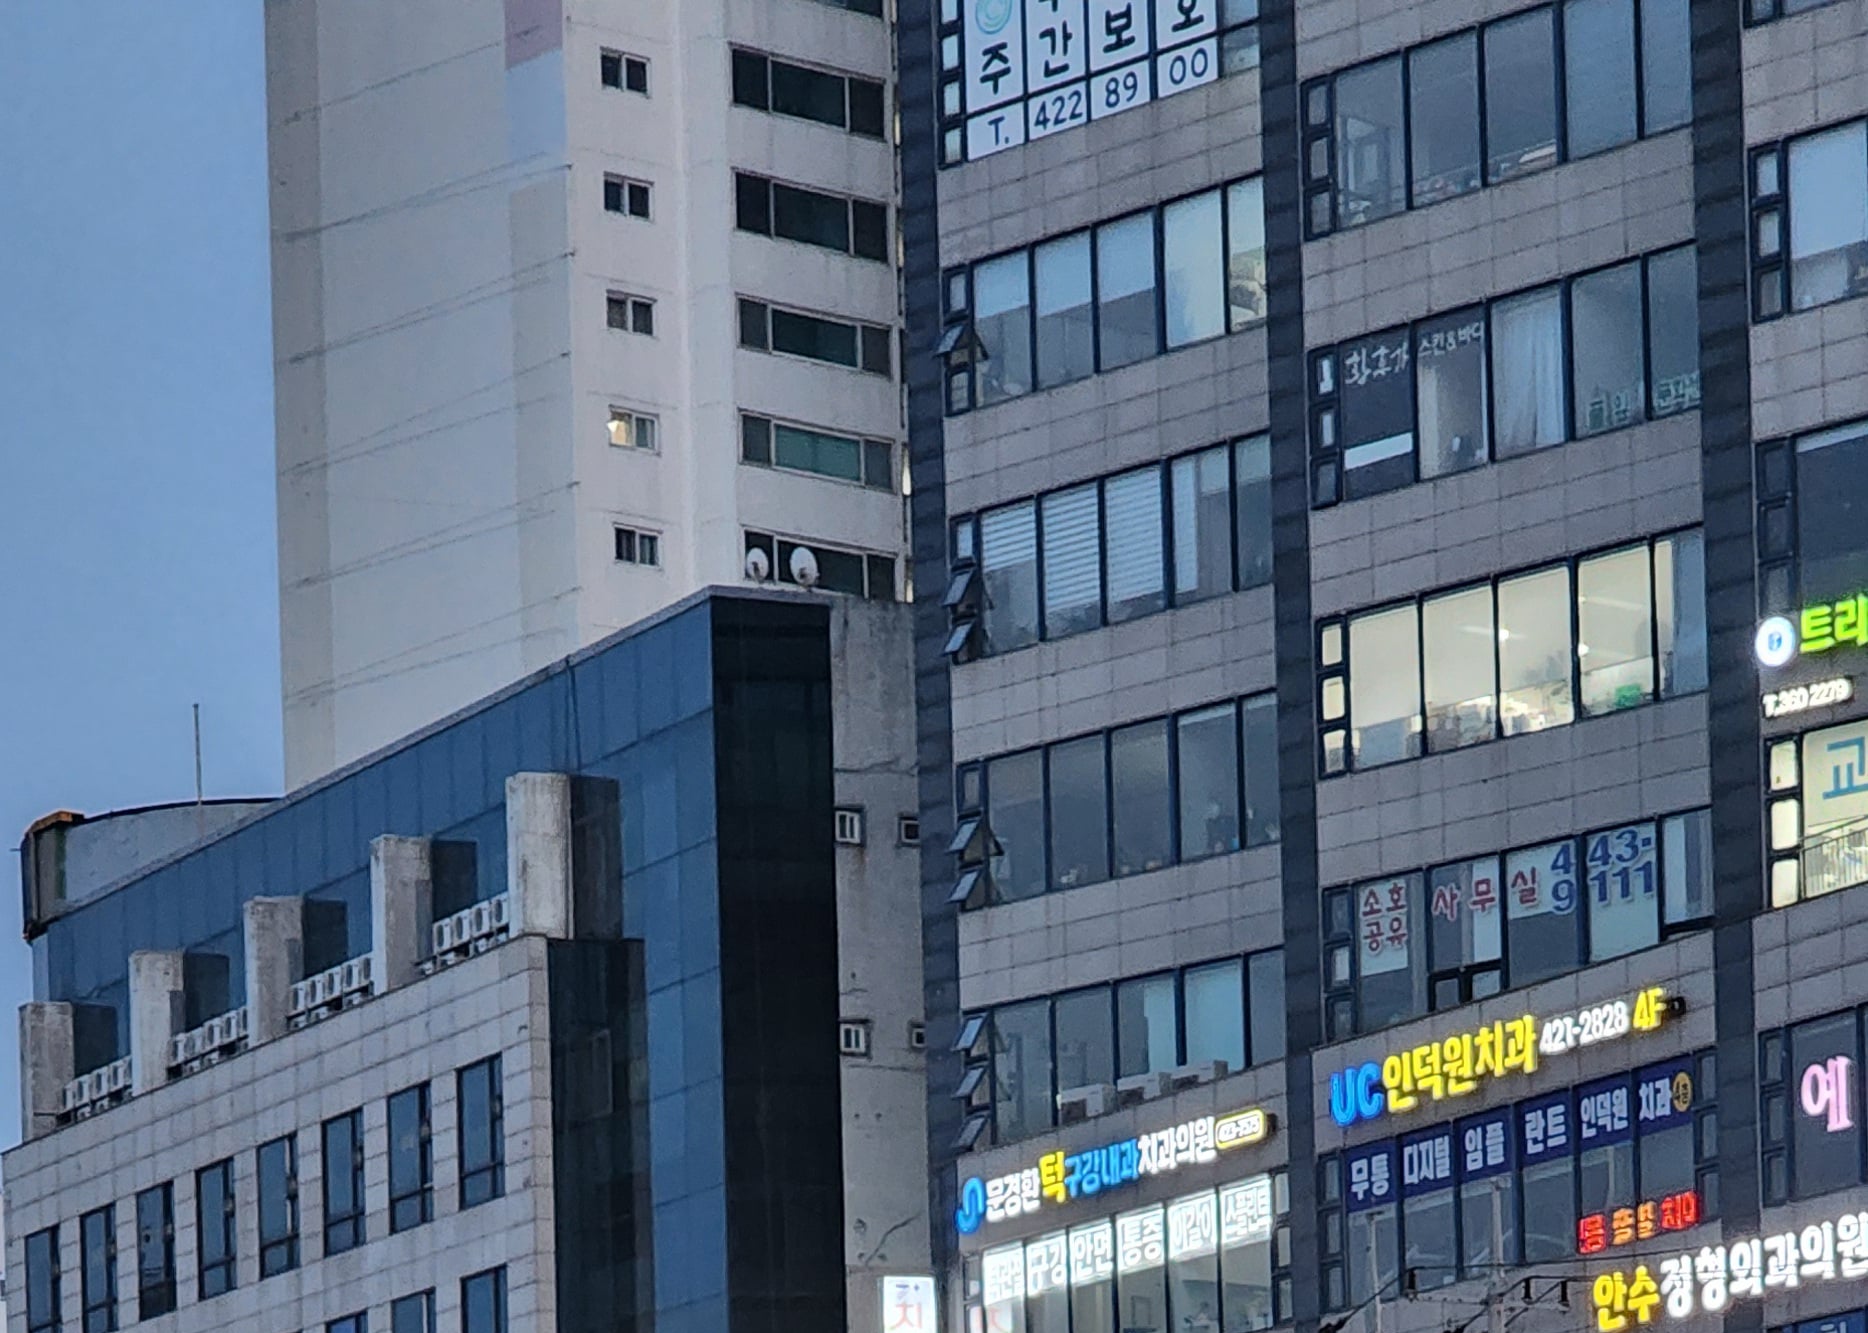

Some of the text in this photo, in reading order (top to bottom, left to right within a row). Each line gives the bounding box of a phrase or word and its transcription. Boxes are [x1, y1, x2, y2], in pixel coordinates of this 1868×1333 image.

[1033, 89, 1084, 130] 422
[1104, 71, 1138, 108] 89
[1169, 48, 1209, 85] 00
[1361, 881, 1407, 917] 소호
[1363, 917, 1408, 953] 공유
[1632, 987, 1667, 1031] 4F
[1351, 1153, 1389, 1201] 무통
[1402, 1134, 1450, 1186] 디지털
[1580, 1087, 1629, 1139] 인덕원
[1638, 1077, 1673, 1122] 치과
[1074, 1225, 1114, 1277] 안면
[1122, 1216, 1163, 1266] 통증
